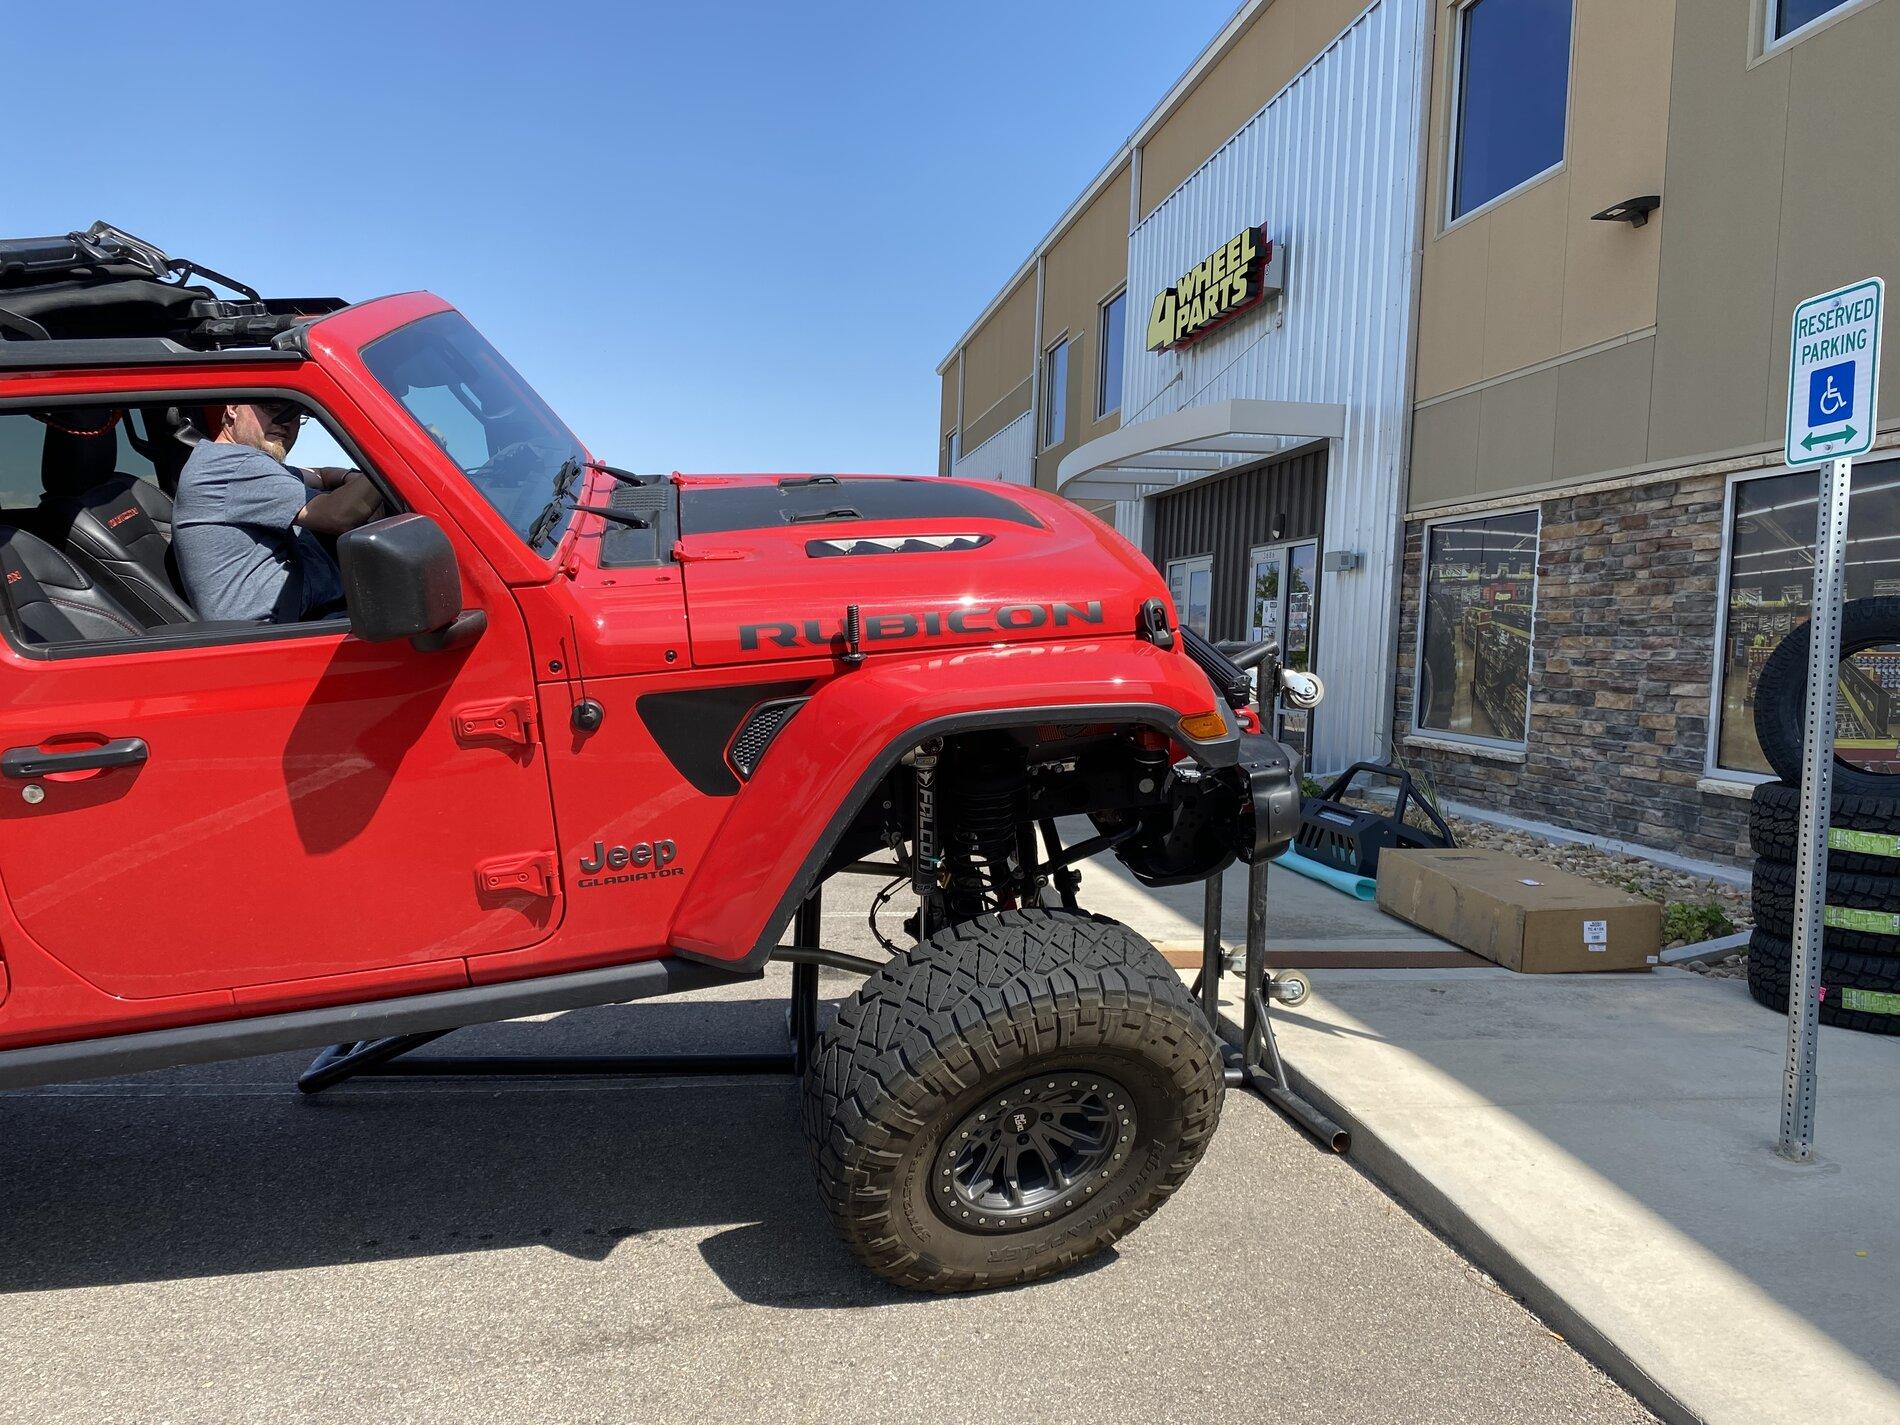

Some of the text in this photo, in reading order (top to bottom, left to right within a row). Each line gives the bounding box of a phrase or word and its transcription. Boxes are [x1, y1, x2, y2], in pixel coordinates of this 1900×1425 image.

[1176, 228, 1256, 308] WHEEL
[1147, 288, 1176, 352] 4
[1175, 261, 1249, 340] PARTS
[1798, 297, 1874, 339] RESERVED
[1801, 328, 1867, 366] PARKING
[738, 600, 1104, 652] RUBICON
[919, 788, 934, 871] FALCON
[577, 867, 685, 888] GLADIATOR
[579, 838, 677, 875] Jeep
